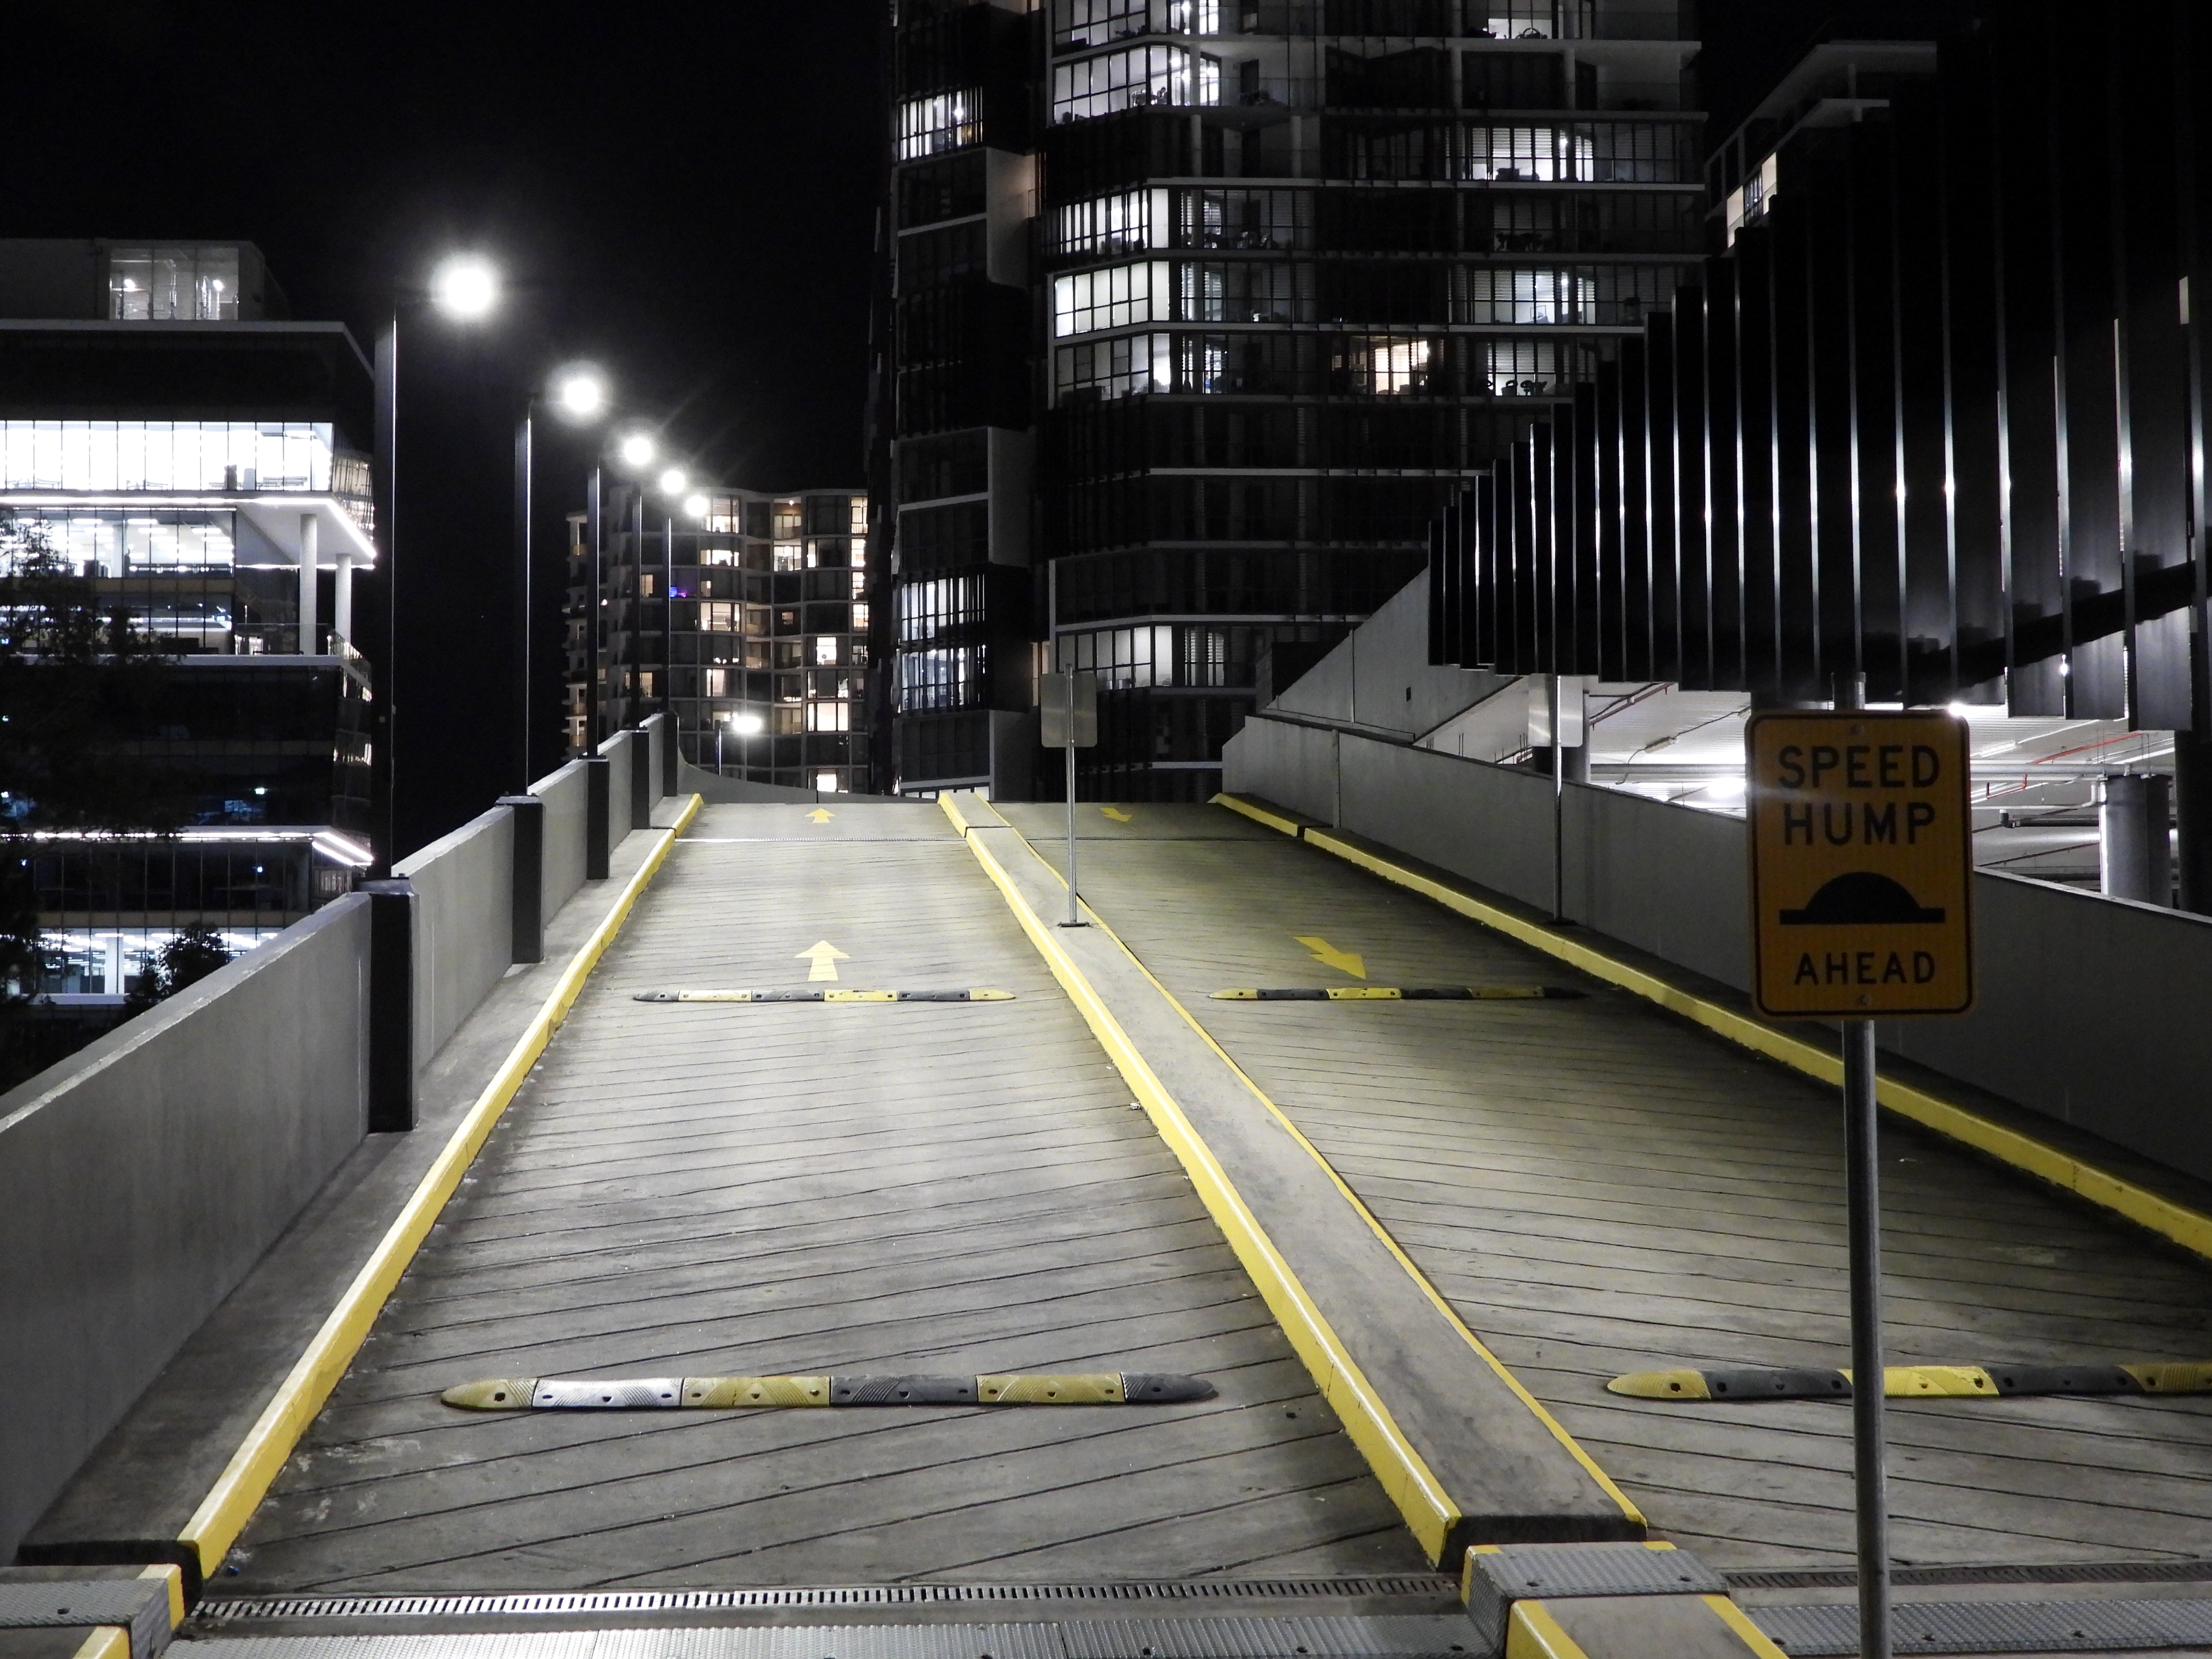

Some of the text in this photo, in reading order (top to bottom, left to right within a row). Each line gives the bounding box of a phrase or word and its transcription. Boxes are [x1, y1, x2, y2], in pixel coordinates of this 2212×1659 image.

[1778, 745, 1940, 789] SPEED
[1784, 802, 1935, 845] HUMP
[1794, 951, 1935, 986] AHEAD
